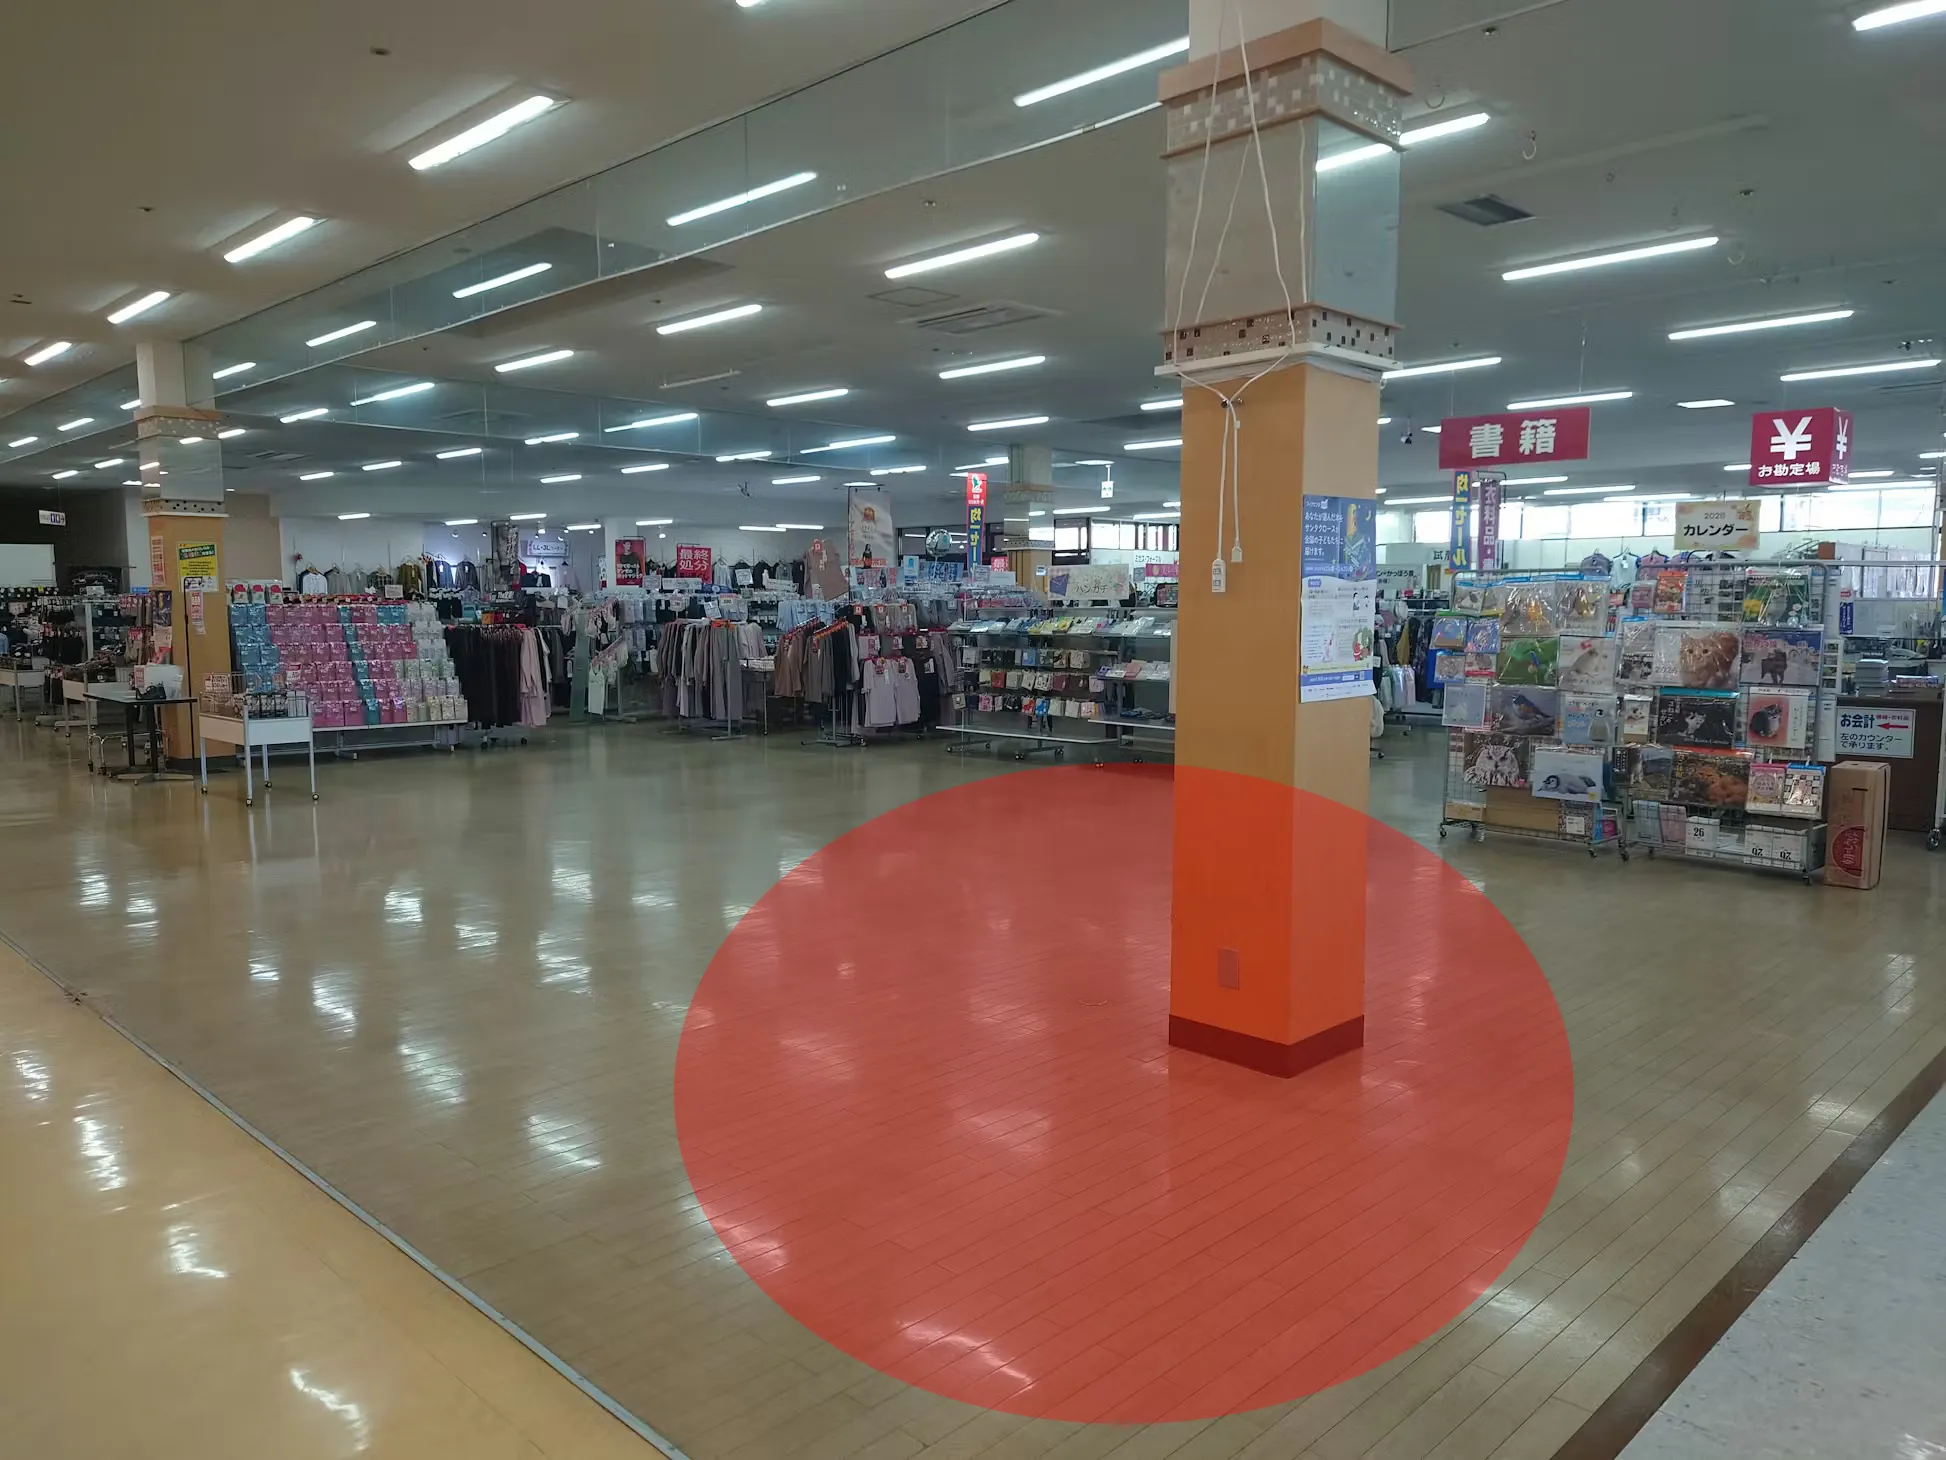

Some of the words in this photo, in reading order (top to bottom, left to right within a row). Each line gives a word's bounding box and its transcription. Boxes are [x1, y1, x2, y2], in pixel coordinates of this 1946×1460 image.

[1469, 419, 1558, 458] 書籍
[1770, 416, 1813, 460] ¥
[1836, 416, 1848, 460] ¥
[1758, 461, 1821, 477] お勘定場
[1483, 485, 1497, 579] 衣料品・書
[1683, 524, 1748, 536] カレンダー
[679, 549, 709, 561] 最終
[680, 560, 709, 571] 処分
[1840, 714, 1876, 729] お会計
[1840, 733, 1903, 742] 左のカウンター
[1841, 741, 1889, 751] で承ります。
[1693, 827, 1705, 837] 26
